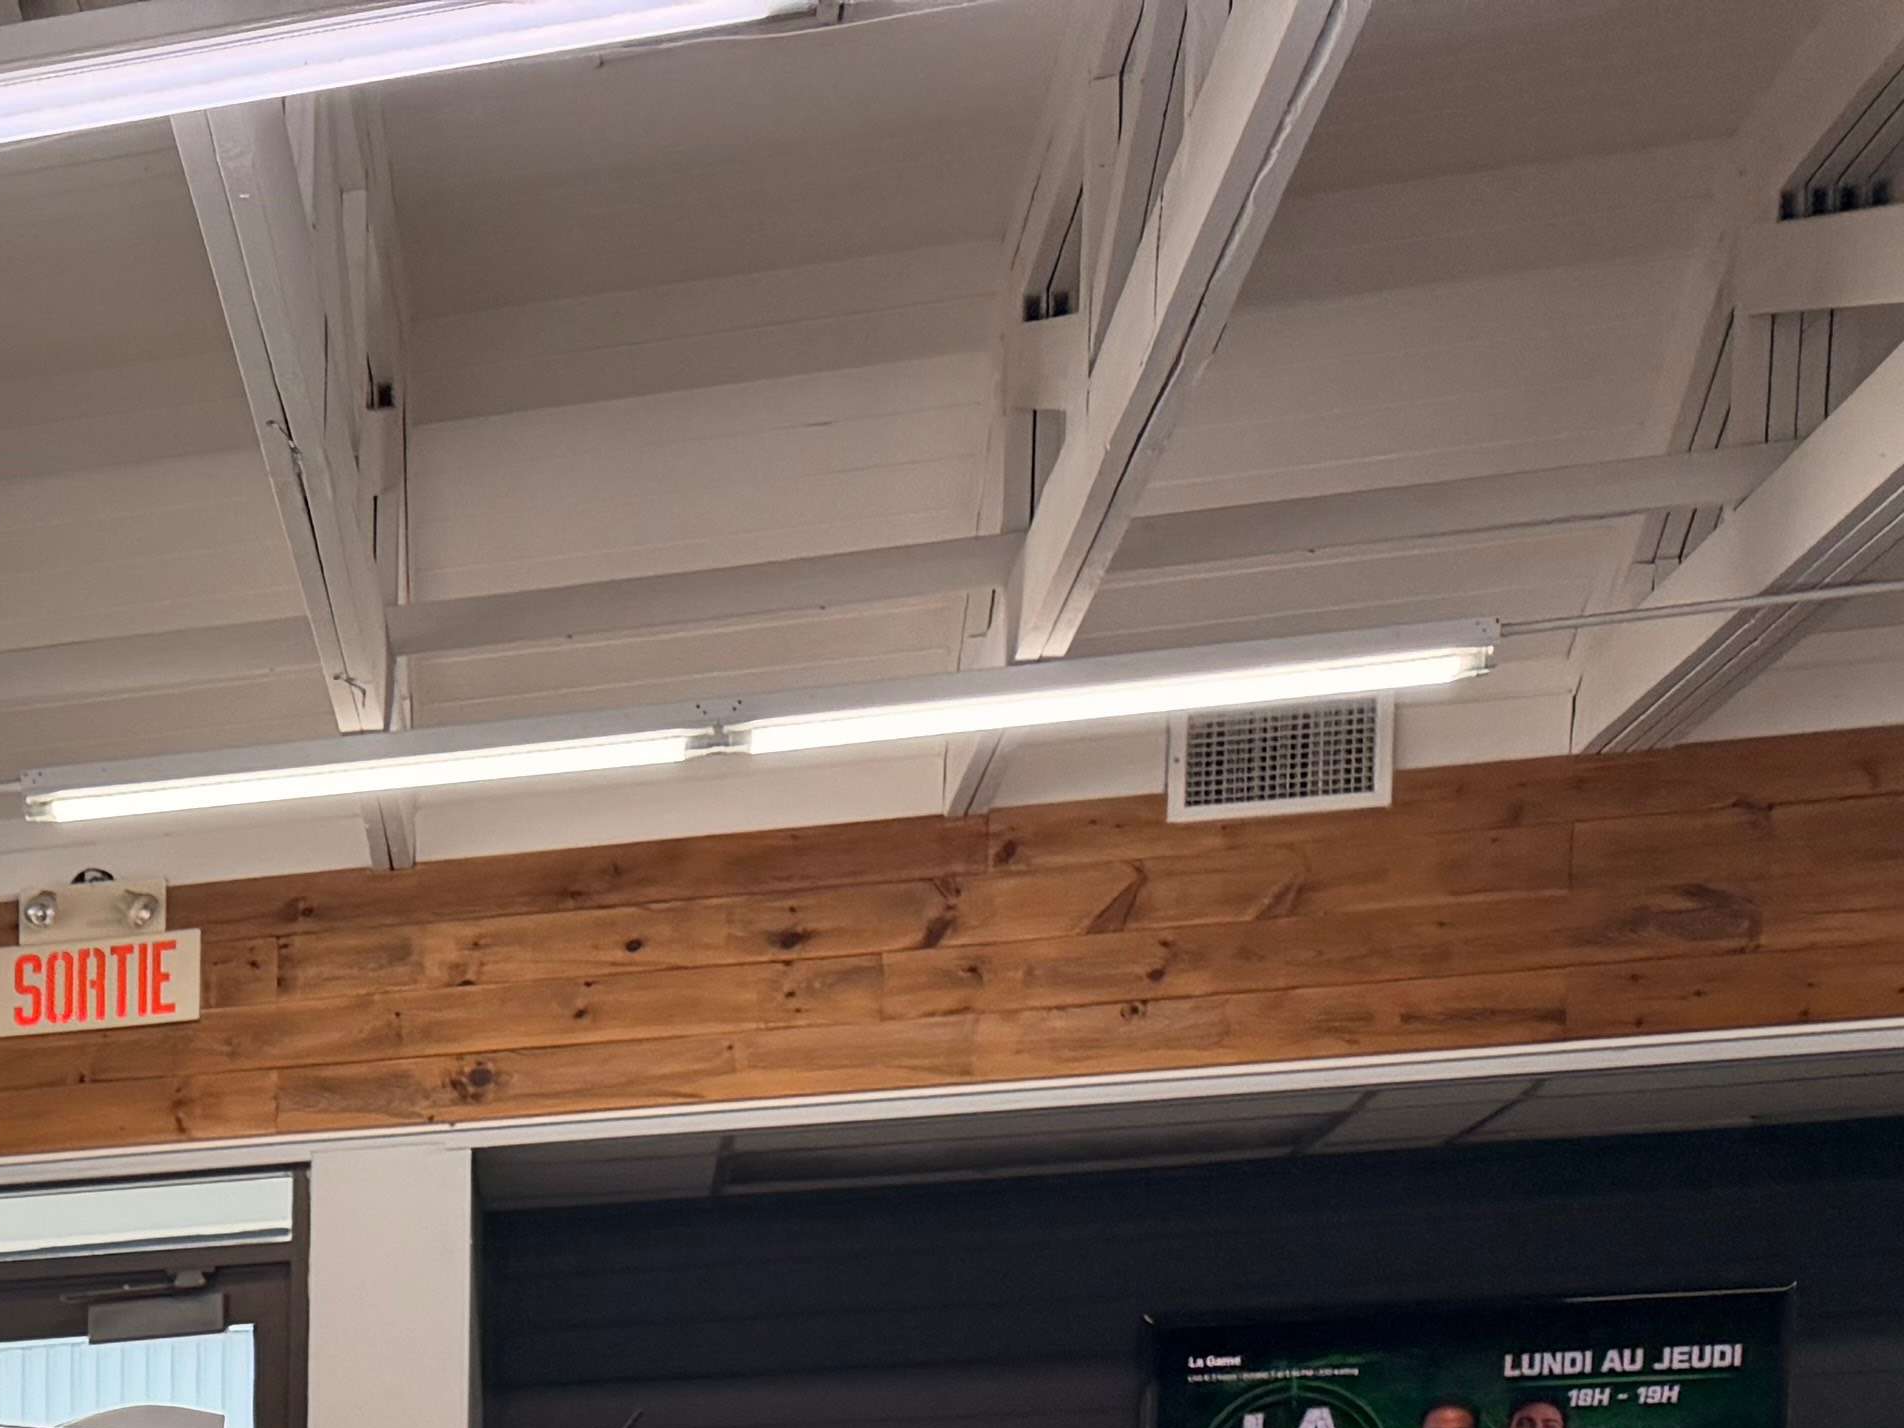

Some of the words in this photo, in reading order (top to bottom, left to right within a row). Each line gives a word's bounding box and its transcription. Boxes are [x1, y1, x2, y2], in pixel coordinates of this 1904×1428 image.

[13, 939, 178, 1027] SORTIE
[1188, 1356, 1204, 1368] La
[1206, 1354, 1241, 1367] Game
[1503, 1351, 1592, 1378] LUNDI
[1600, 1348, 1644, 1373] AU
[1653, 1344, 1743, 1371] JEUDI
[1568, 1387, 1611, 1407] 18H
[1637, 1384, 1681, 1404] 19H
